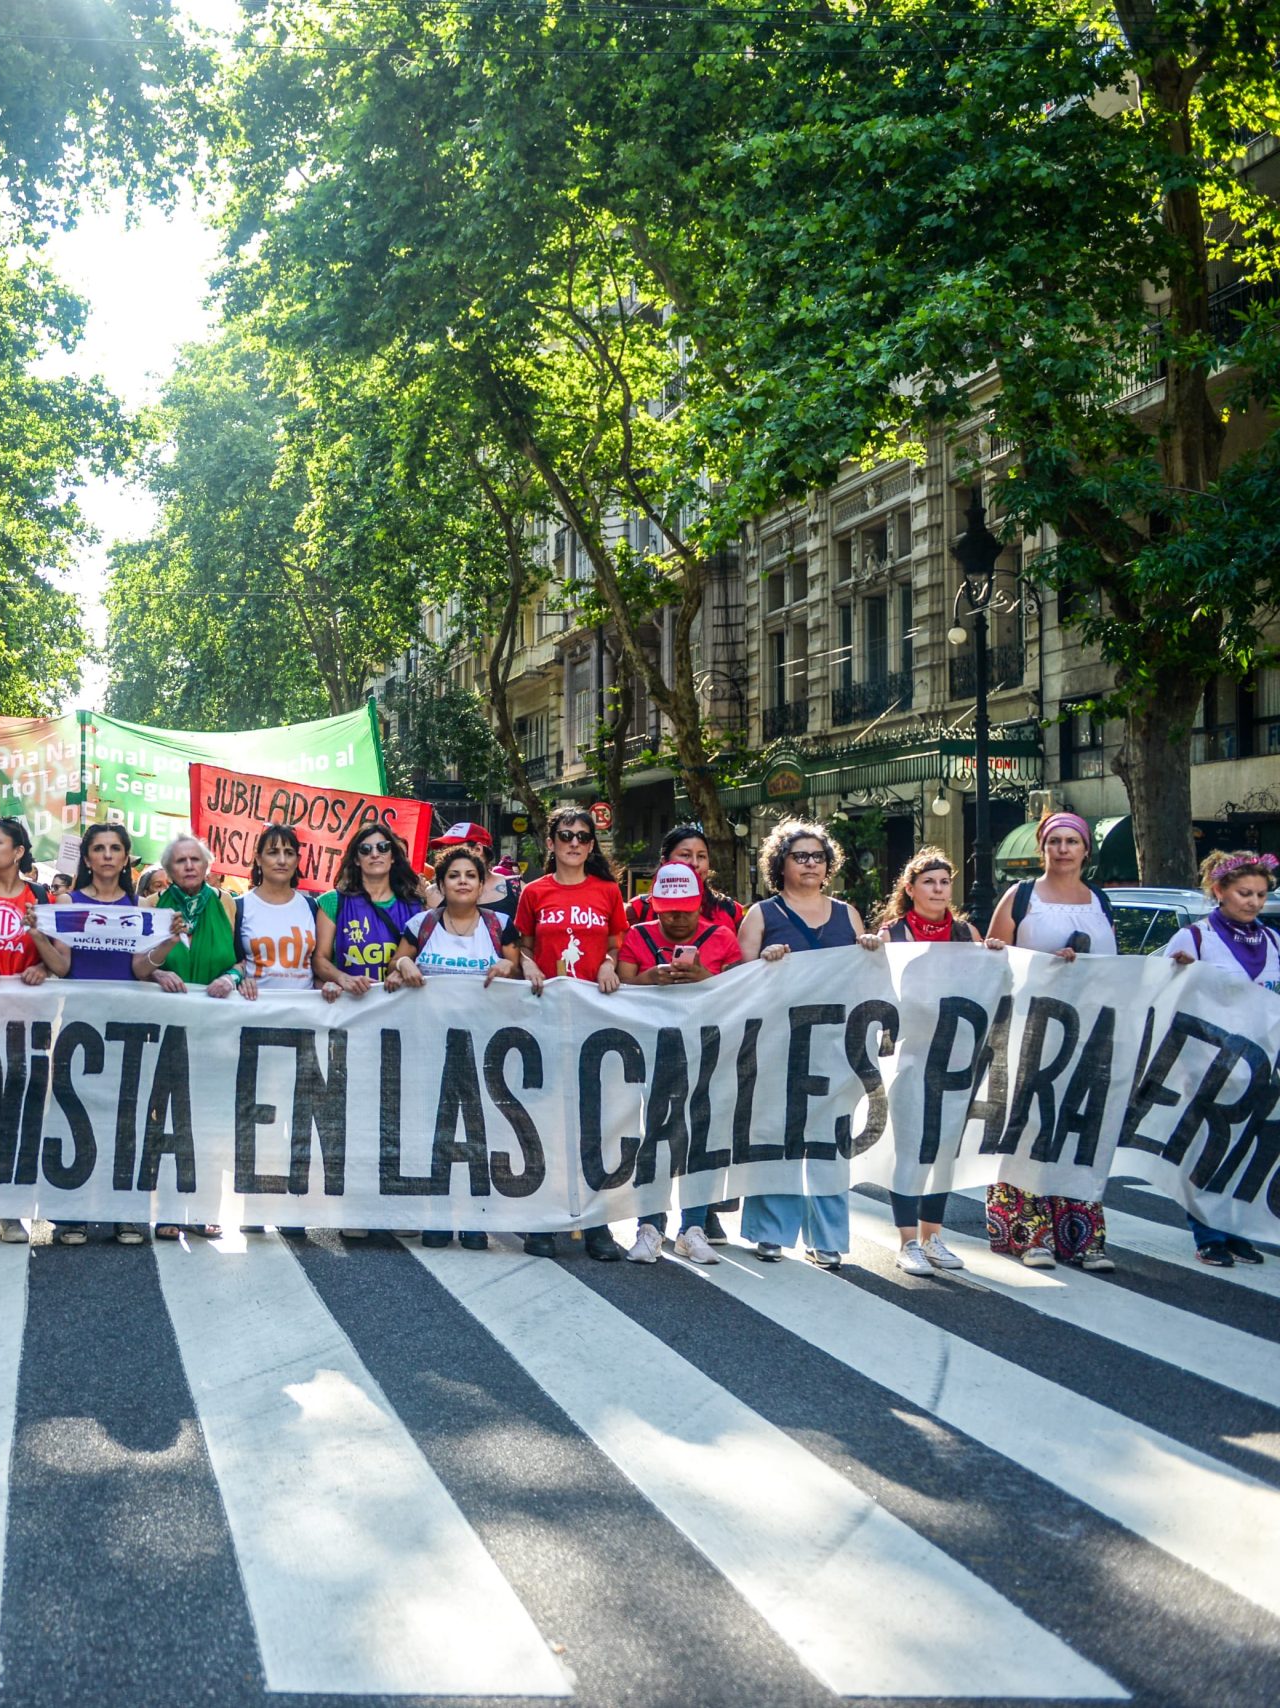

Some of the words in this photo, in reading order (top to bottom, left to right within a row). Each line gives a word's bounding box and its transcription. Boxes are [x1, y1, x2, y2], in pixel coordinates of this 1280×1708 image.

[964, 755, 1017, 770] TOTONI
[234, 1026, 348, 1196] EN
[379, 1026, 547, 1198] LAS
[577, 998, 901, 1192] CALLES
[919, 994, 1116, 1167] PARA
